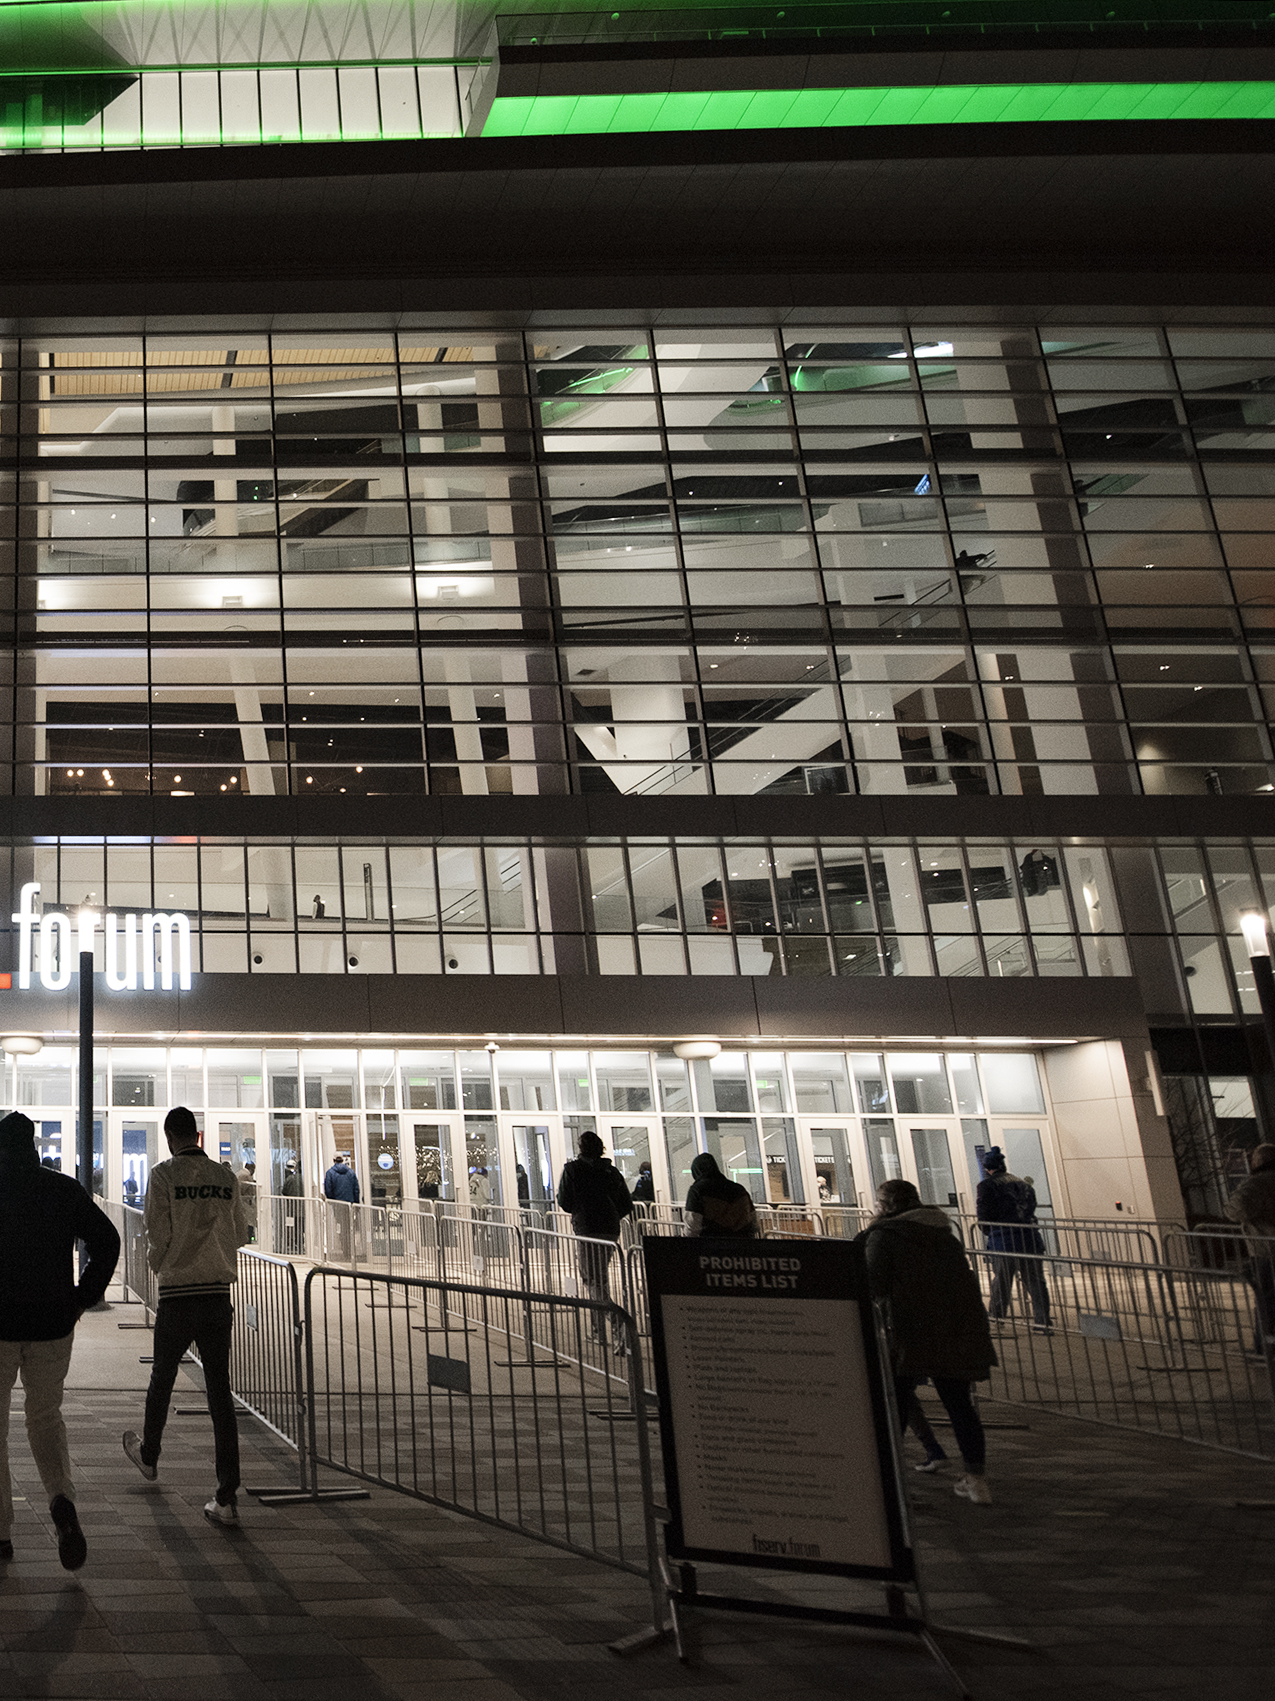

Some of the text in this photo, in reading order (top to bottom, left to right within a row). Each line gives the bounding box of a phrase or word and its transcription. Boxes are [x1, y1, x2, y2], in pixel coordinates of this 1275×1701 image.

[174, 1184, 233, 1200] BUCKS
[699, 1256, 801, 1271] PROHIBITED
[706, 1273, 798, 1289] ITEMS LIST
